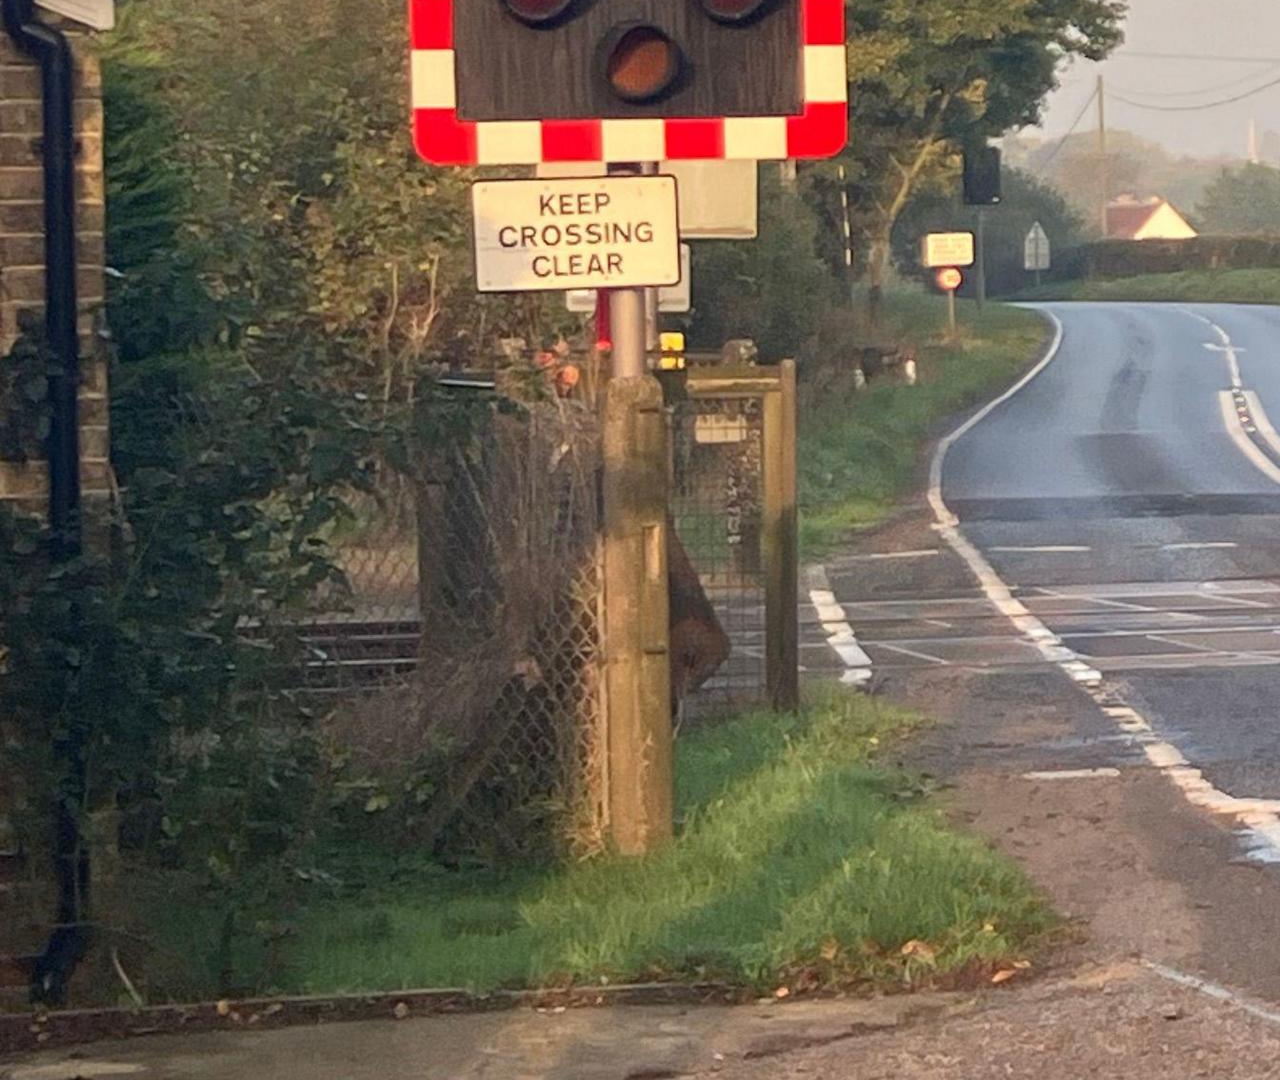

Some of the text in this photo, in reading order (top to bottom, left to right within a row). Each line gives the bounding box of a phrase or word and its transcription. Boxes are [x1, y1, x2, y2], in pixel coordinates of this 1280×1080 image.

[539, 192, 610, 216] KEEP
[498, 221, 653, 248] CROSSING
[532, 253, 624, 277] CLEAR
